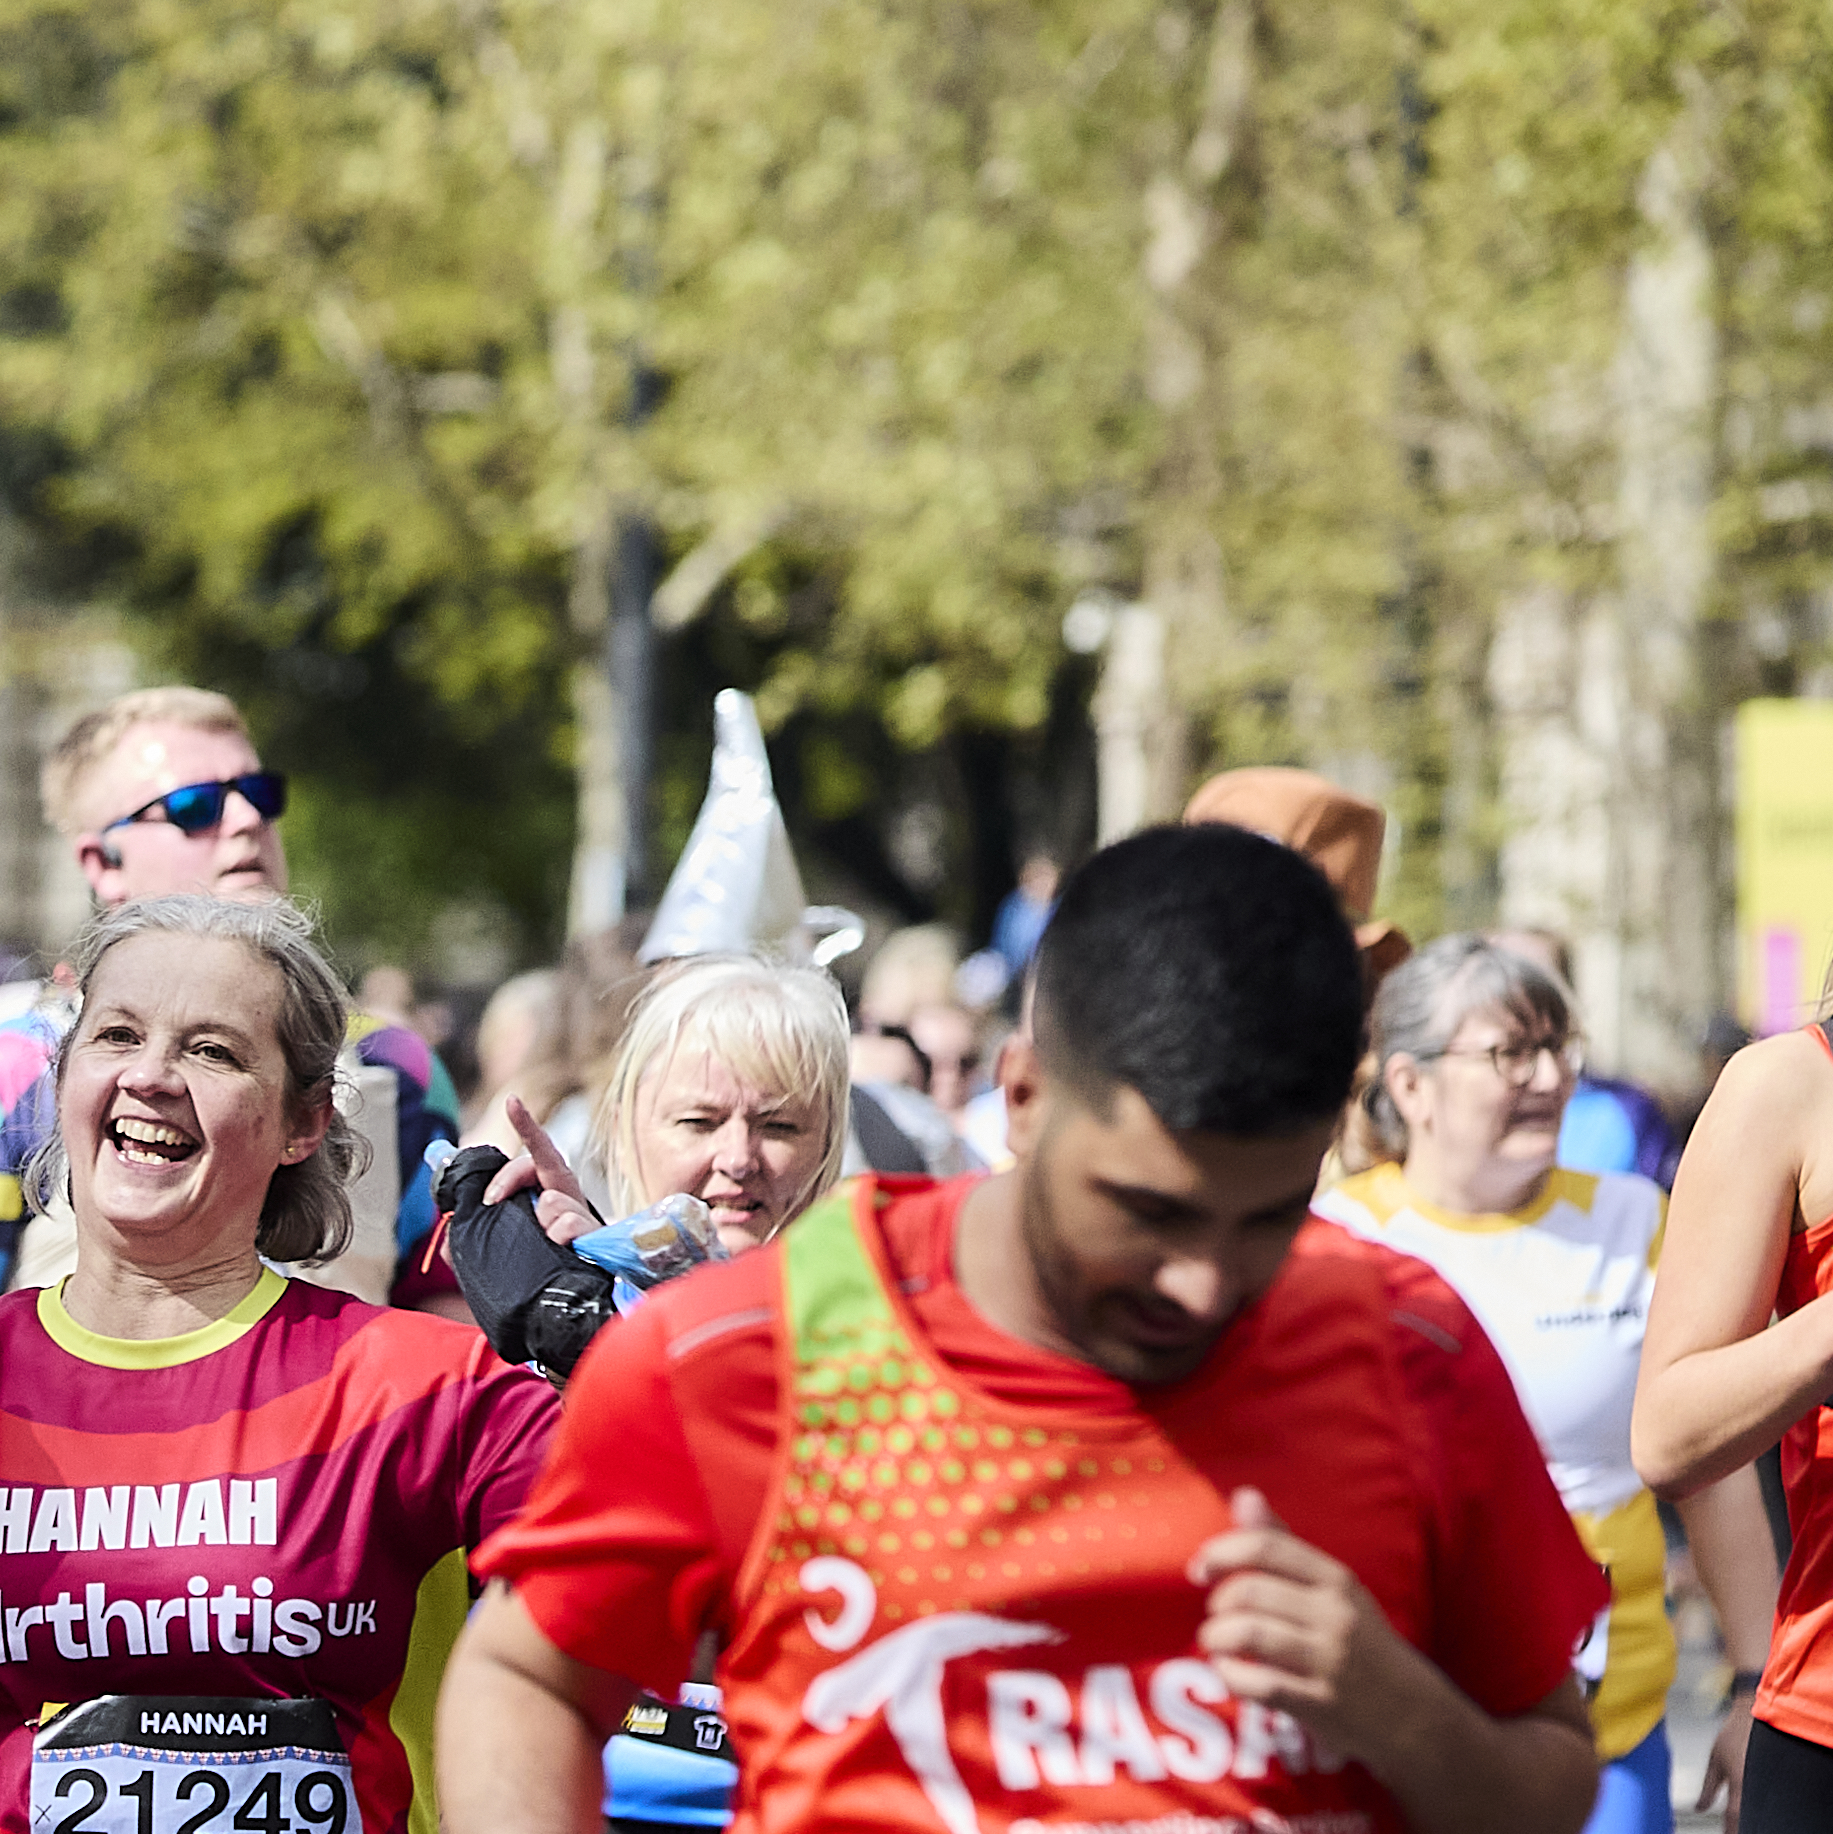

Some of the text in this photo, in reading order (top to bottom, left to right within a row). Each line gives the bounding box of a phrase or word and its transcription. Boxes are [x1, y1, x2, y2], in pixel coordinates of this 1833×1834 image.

[326, 1599, 377, 1637] UK
[140, 1711, 268, 1737] HANNAH
[986, 1657, 1343, 1791] RASA
